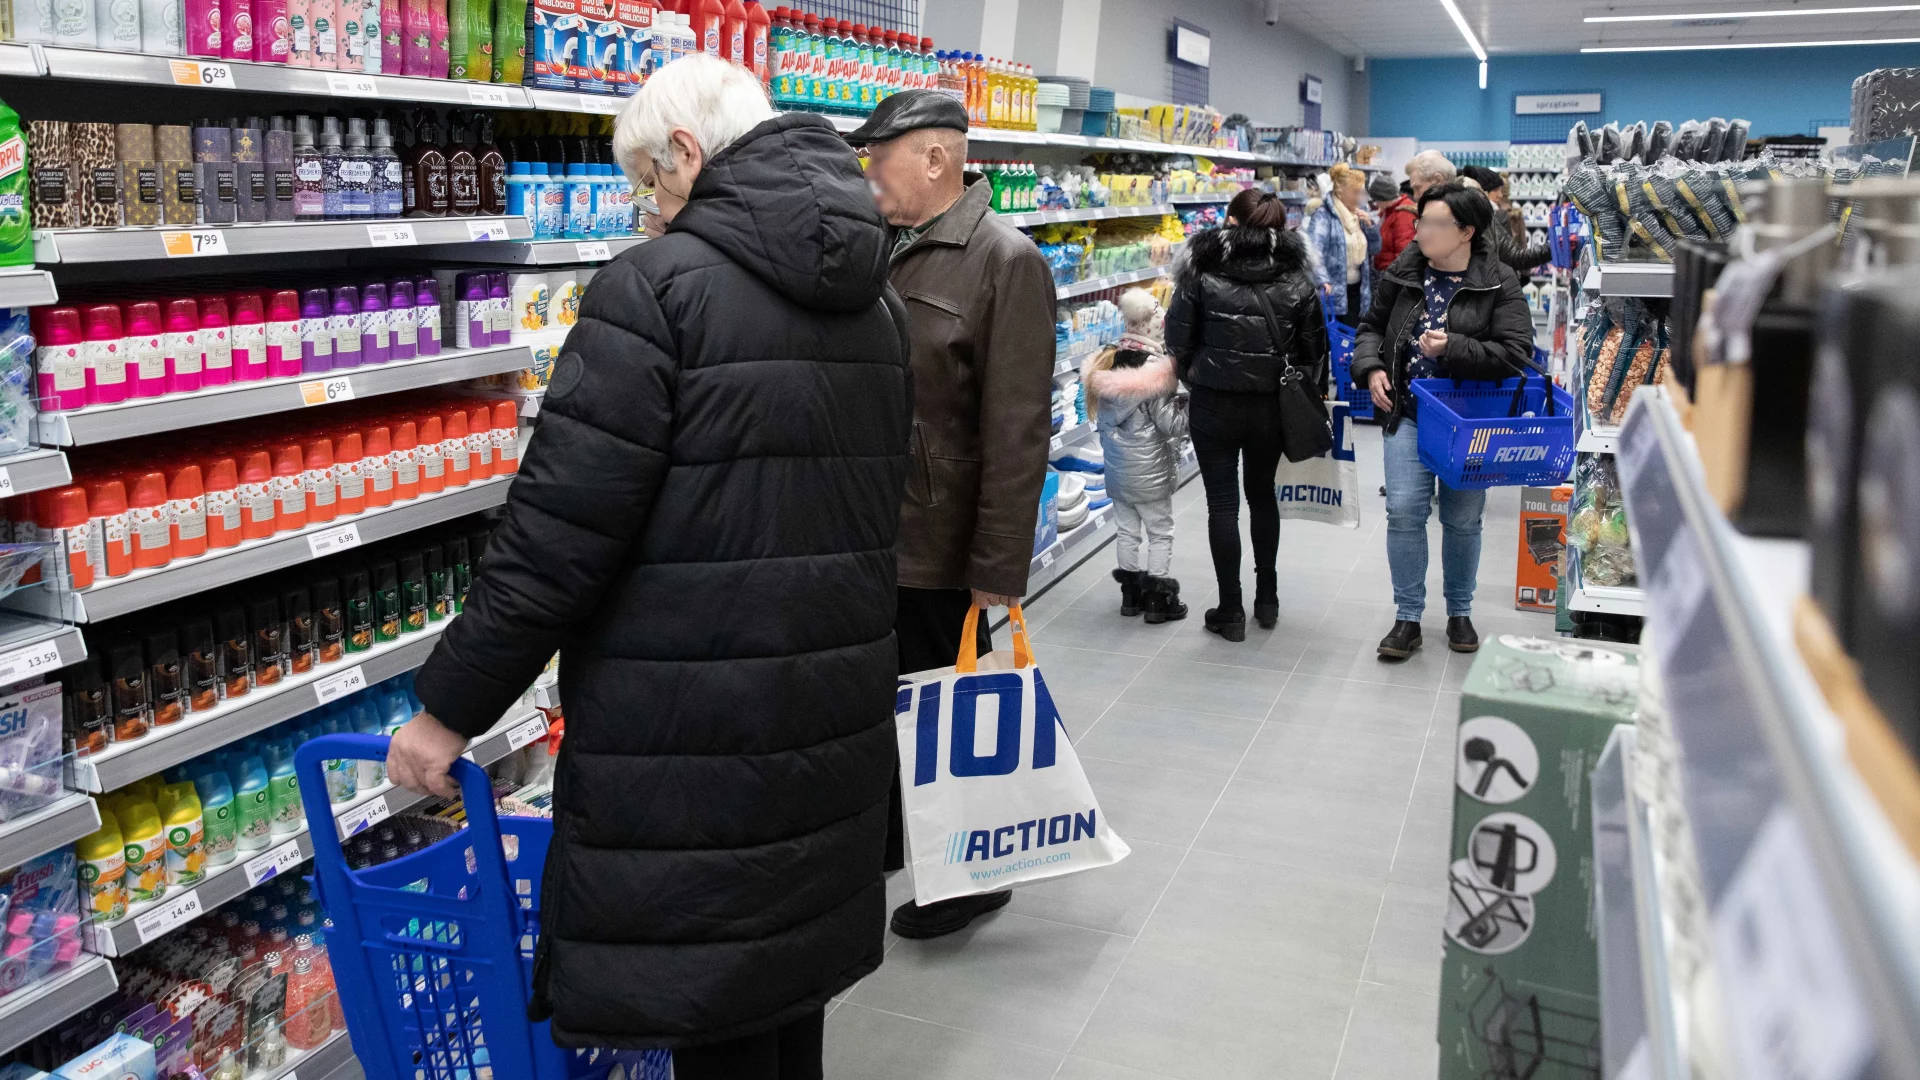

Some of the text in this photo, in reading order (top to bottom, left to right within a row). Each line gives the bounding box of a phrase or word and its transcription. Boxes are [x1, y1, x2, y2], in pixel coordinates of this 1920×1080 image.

[619, 2, 650, 16] DUO DRAIN
[619, 13, 650, 24] UNBLOCKER
[356, 82, 372, 92] 4.59
[1536, 101, 1580, 110] sprzątanie
[10, 194, 23, 205] GEL
[490, 227, 504, 235] 9.99
[1493, 445, 1550, 463] ACTION
[1280, 485, 1342, 507] ACTION
[1525, 500, 1547, 512] TOOL
[338, 533, 354, 544] 6.99
[28, 651, 58, 668] 13.59
[343, 676, 360, 688] 7.49
[26, 687, 61, 702] LAVENDER
[368, 804, 387, 819] 14.49
[965, 808, 1096, 862] ACTION
[278, 848, 300, 866] 14.49
[969, 850, 1071, 880] www.action.com
[171, 900, 196, 919] 14.49
[189, 1069, 199, 1078] 33
